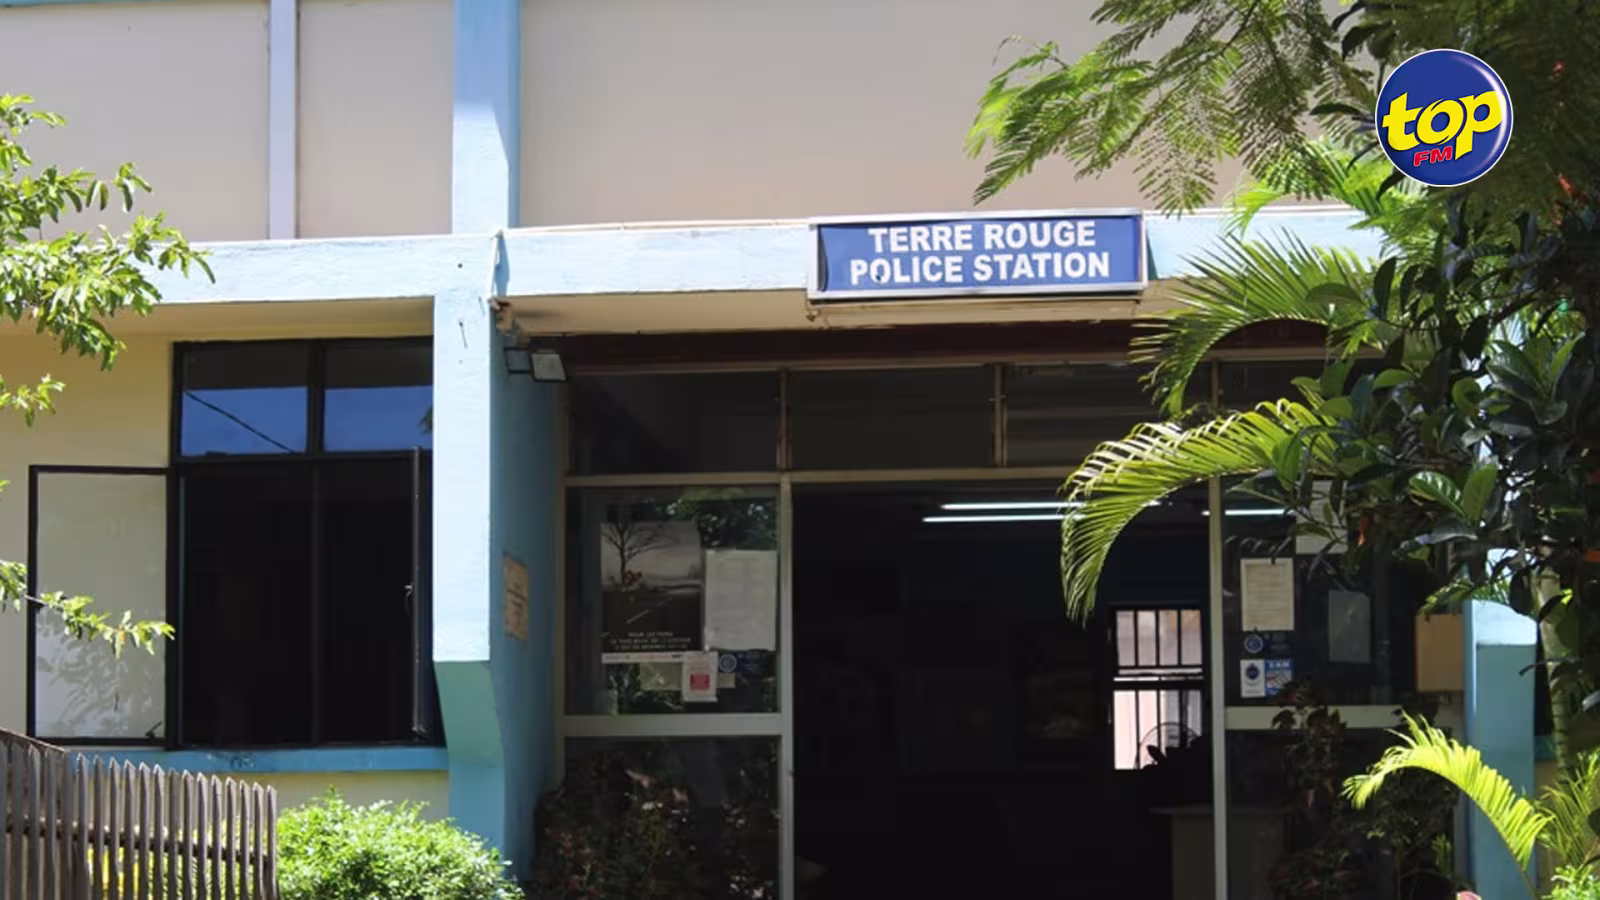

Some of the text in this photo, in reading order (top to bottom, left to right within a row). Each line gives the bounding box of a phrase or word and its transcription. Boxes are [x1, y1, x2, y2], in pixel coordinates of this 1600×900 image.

[868, 221, 1096, 252] TERRE ROUGE
[850, 252, 1110, 285] POLICE STATION
